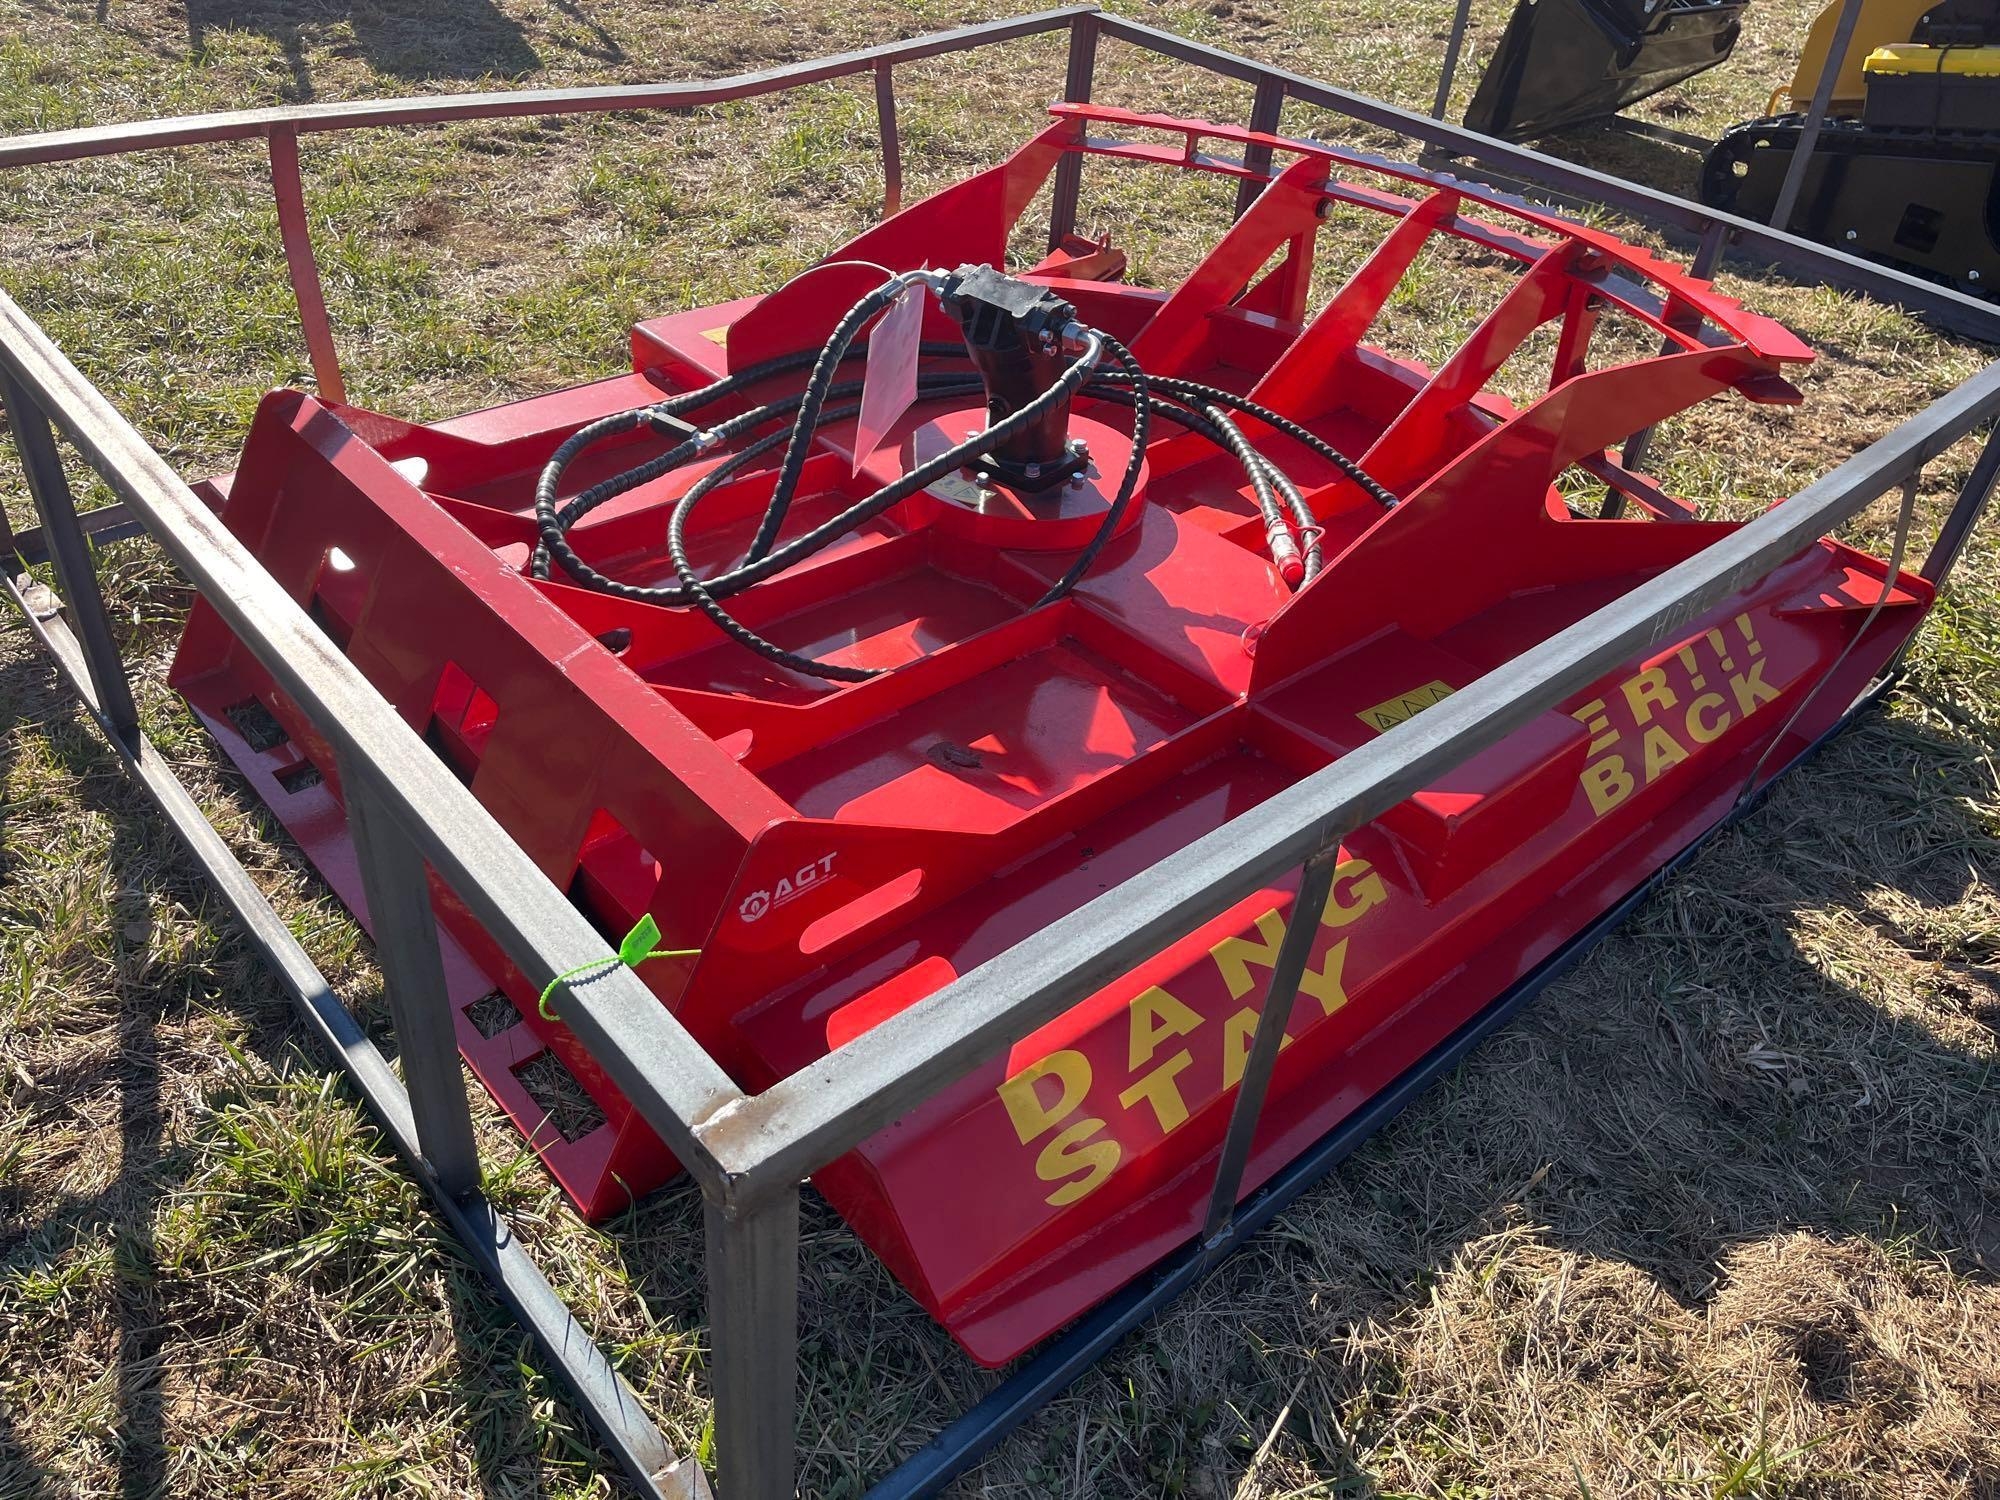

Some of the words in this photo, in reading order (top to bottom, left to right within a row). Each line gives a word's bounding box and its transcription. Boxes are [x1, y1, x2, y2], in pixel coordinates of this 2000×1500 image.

[774, 851, 837, 900] AGT
[1035, 936, 1349, 1206] STAY
[1579, 657, 1782, 817] BACK
